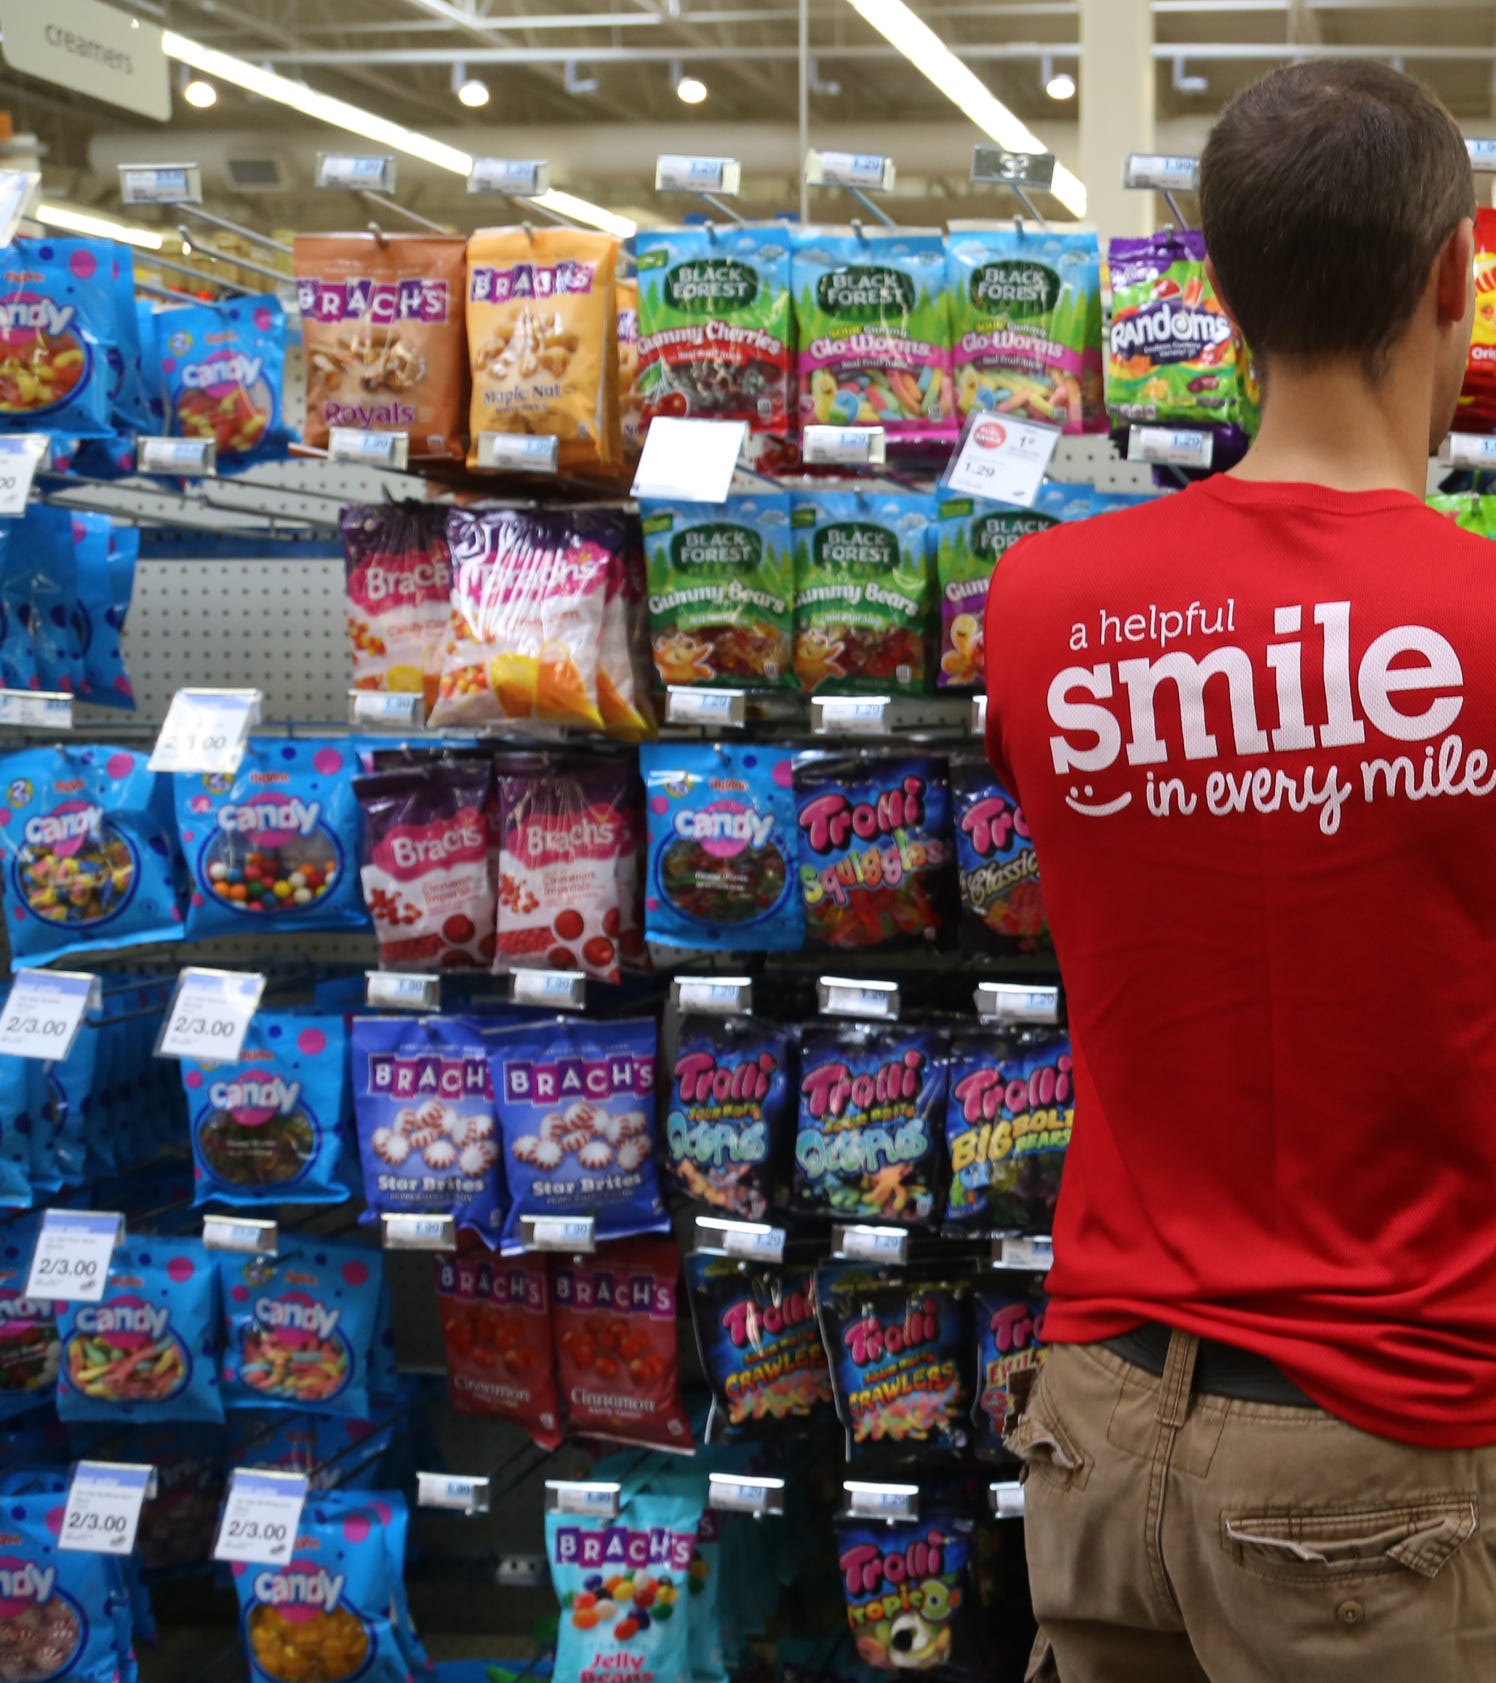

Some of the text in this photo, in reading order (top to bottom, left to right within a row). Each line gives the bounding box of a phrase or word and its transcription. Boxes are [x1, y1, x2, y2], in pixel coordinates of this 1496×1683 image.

[45, 20, 134, 78] creamers
[673, 280, 748, 298] FOREST
[679, 267, 743, 283] BLACK
[832, 273, 898, 291] BLACK
[985, 268, 1045, 285] BLACK
[827, 287, 905, 305] FOREST
[707, 321, 782, 355] Cherries
[181, 354, 262, 391] candy
[324, 401, 415, 428] Royals
[965, 462, 995, 476] 1.29
[680, 545, 751, 563] FOREST
[685, 530, 745, 548] BLACK
[821, 544, 890, 563] FOREST
[827, 530, 884, 547] BLACK
[648, 581, 785, 615] Gummy Bears
[866, 582, 920, 616] Bears
[1069, 598, 1236, 651] a helpful
[1046, 600, 1464, 775] smile
[218, 798, 320, 835] candy
[799, 776, 923, 852] Trolli
[1146, 771, 1197, 817] in
[1206, 765, 1352, 836] every
[25, 804, 104, 844] candy
[675, 808, 775, 849] candy
[7, 1016, 66, 1036] 2/3.00
[175, 1016, 234, 1037] 2/3.00
[675, 1051, 774, 1102] Trolli
[802, 1049, 922, 1117] Trolli
[954, 1054, 1073, 1122] Trolli
[208, 1079, 299, 1116] candy
[951, 1124, 1013, 1172] BIG
[378, 1173, 485, 1194] Star Brites
[532, 1172, 643, 1197] Star Brites
[40, 1259, 98, 1278] 2/3.00
[75, 1305, 169, 1342] candy
[255, 1297, 340, 1335] candy
[845, 1299, 937, 1366] Trolli
[454, 1376, 531, 1402] Cinnamon
[570, 1387, 656, 1413] Cinnamon
[68, 1511, 127, 1532] 2/3.00
[228, 1521, 287, 1540] 2/3.00
[840, 1531, 942, 1595] Trolli
[255, 1570, 344, 1605] candy
[591, 1652, 645, 1674] Jelly
